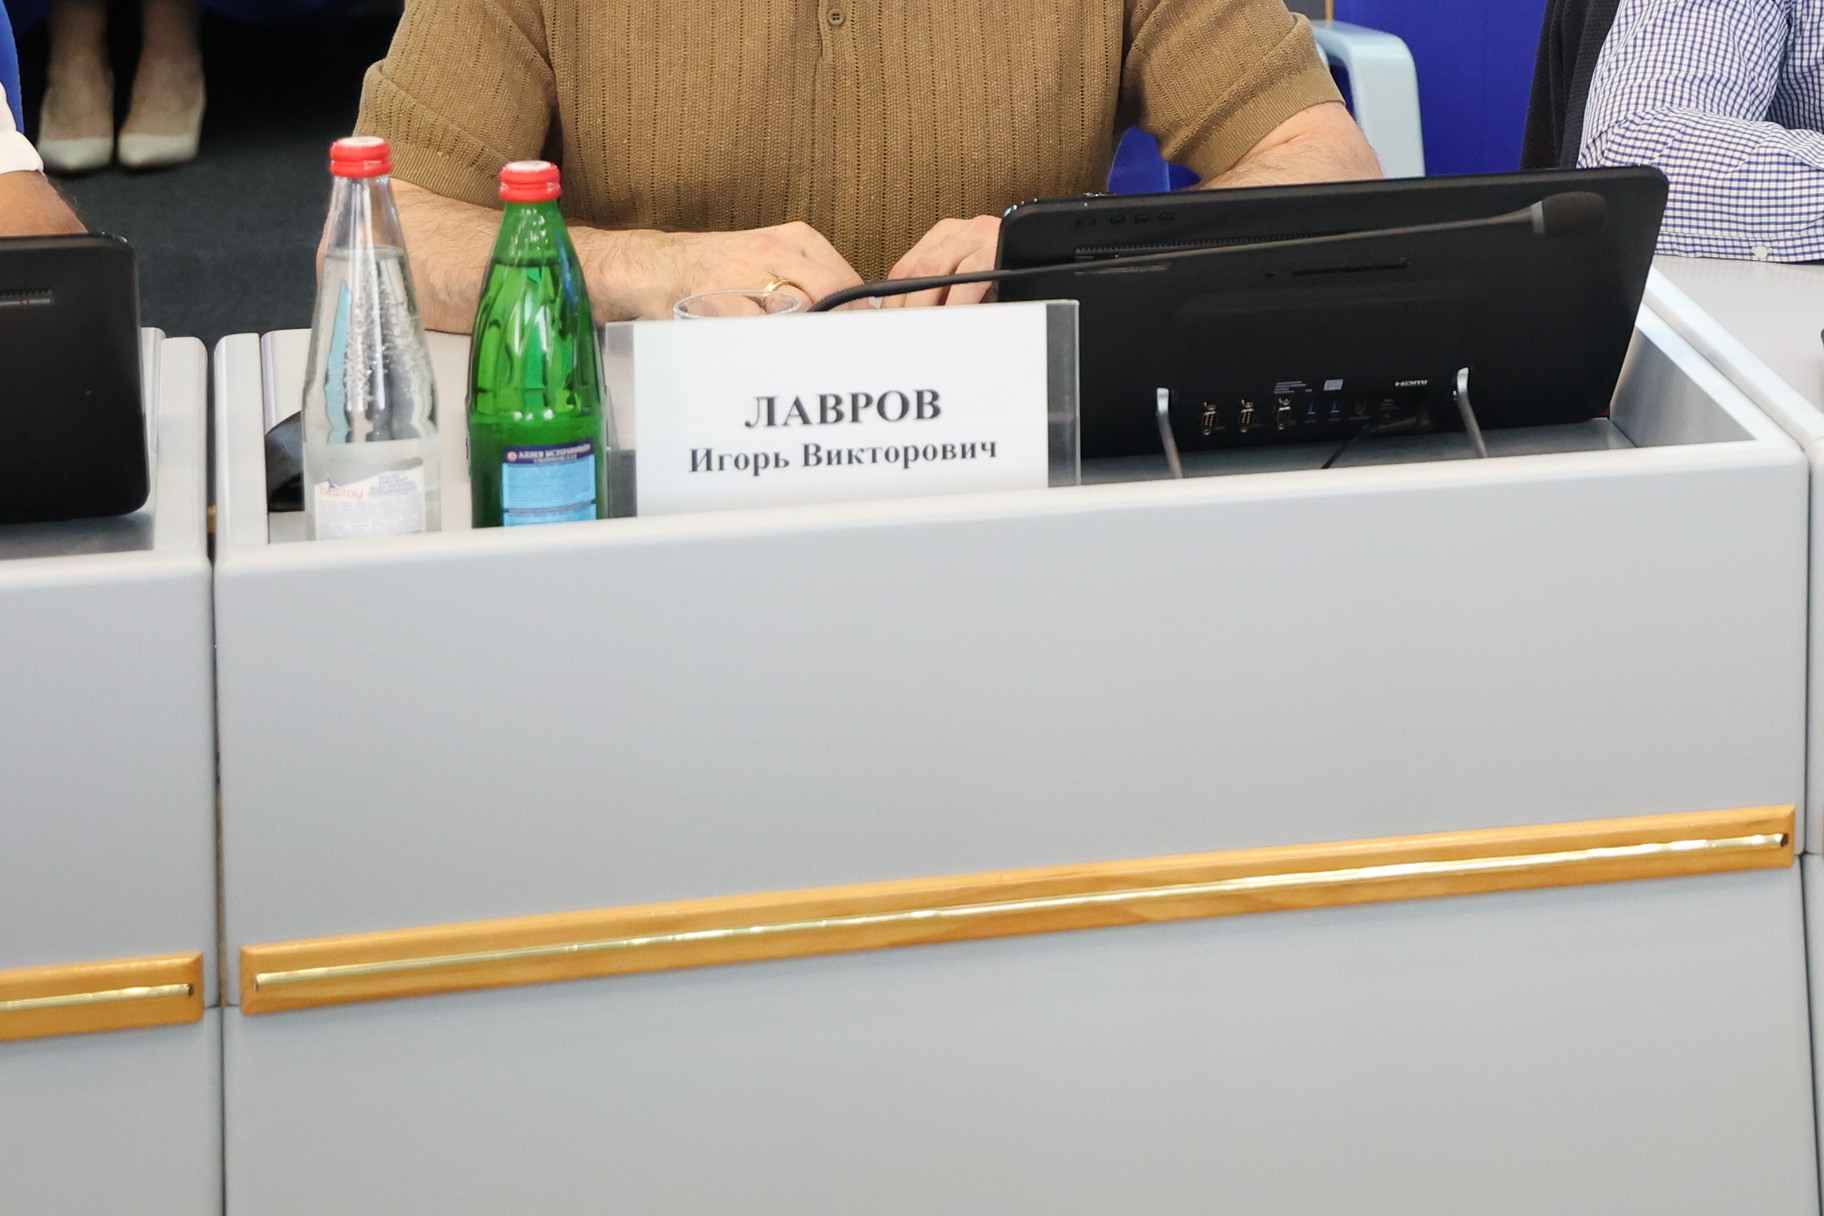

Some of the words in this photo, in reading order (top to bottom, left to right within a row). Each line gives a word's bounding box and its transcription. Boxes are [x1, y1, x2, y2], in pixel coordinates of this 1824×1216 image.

[744, 388, 942, 429] ЛАВРОВ
[690, 447, 791, 477] Игорь
[802, 440, 997, 471] Викторович
